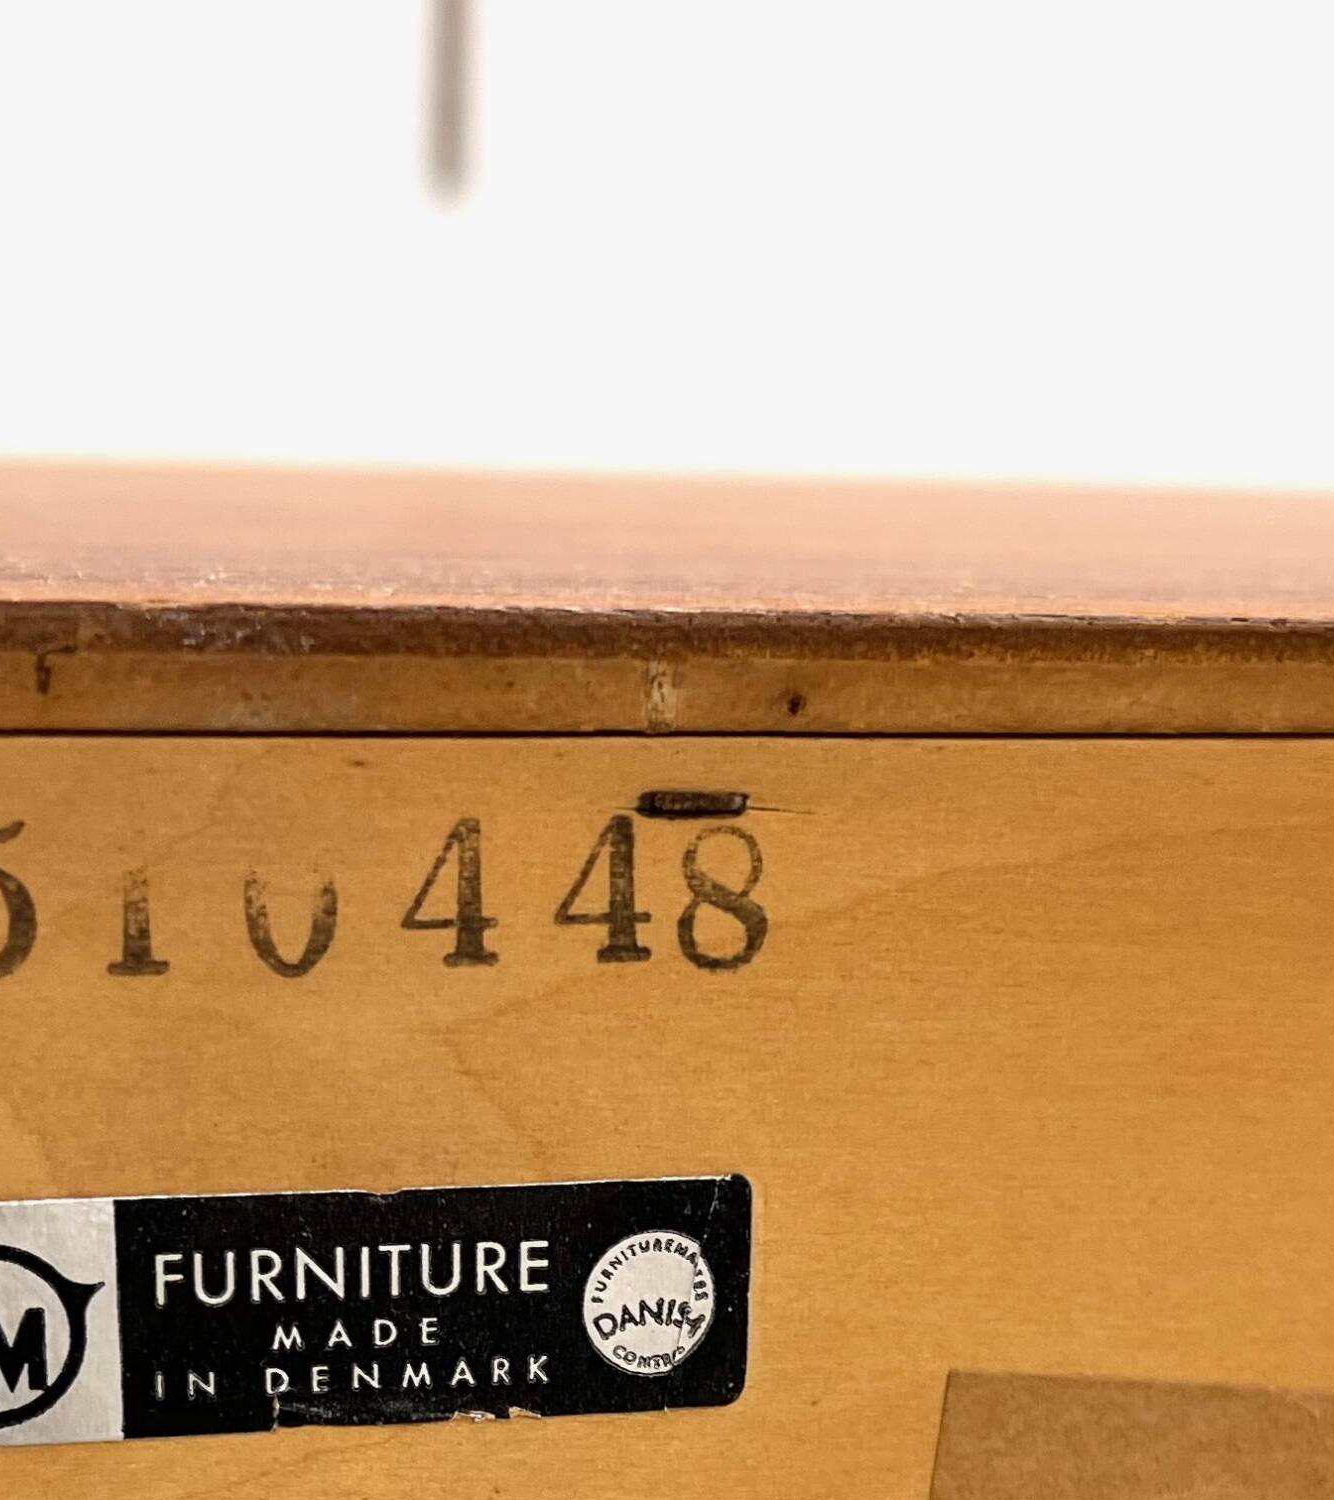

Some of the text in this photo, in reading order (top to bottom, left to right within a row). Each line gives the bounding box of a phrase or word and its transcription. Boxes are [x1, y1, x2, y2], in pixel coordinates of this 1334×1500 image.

[154, 1238, 551, 1308] FURNITURE
[272, 1316, 440, 1351] MADE
[154, 1354, 551, 1401] IN DENMARK
